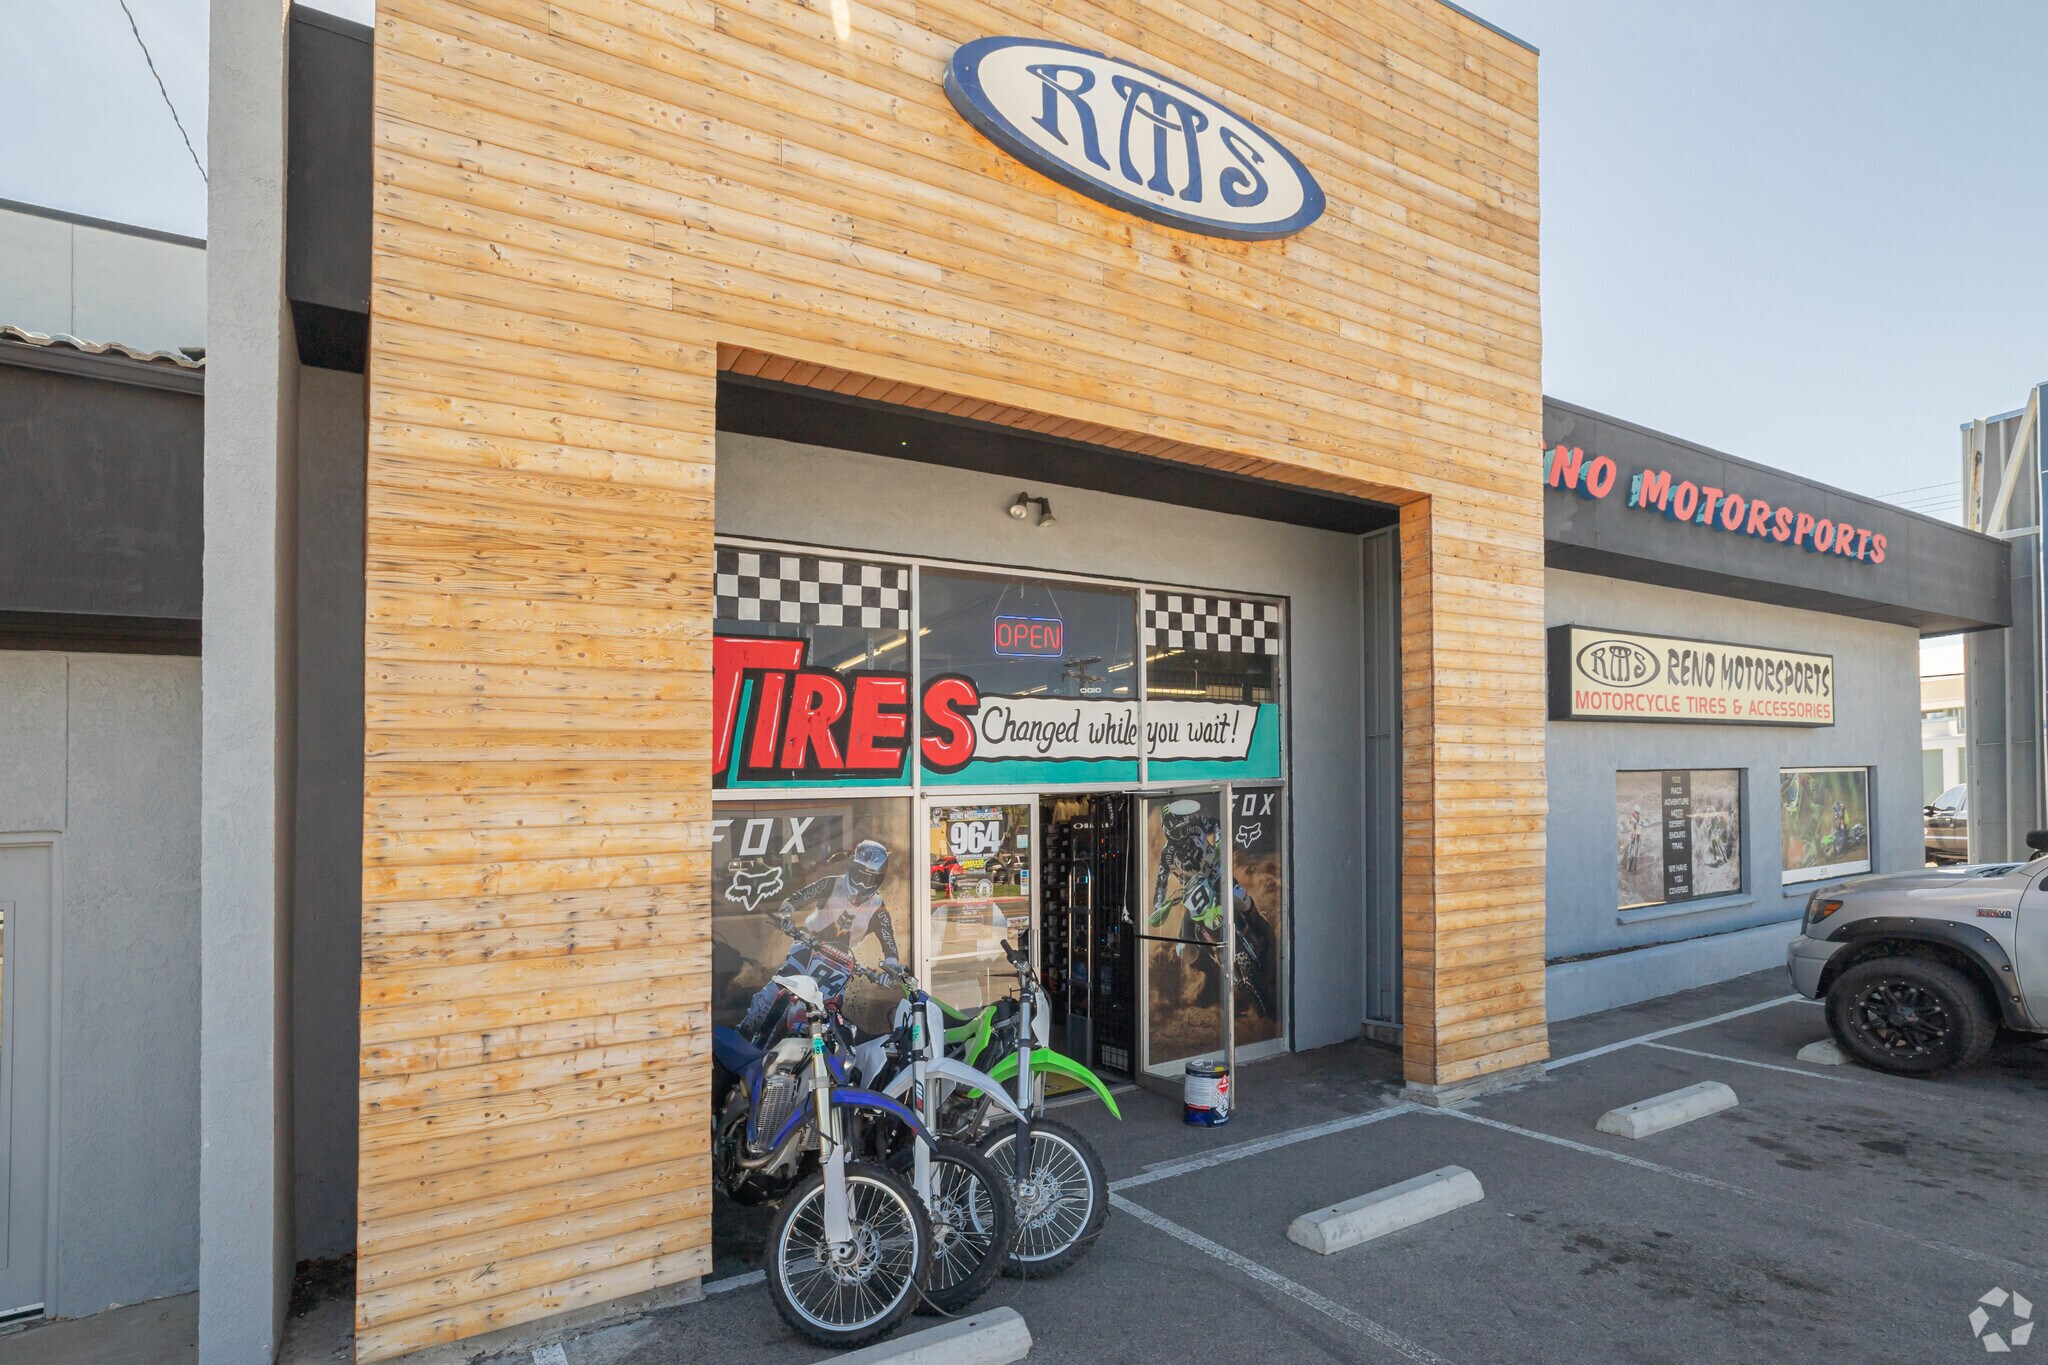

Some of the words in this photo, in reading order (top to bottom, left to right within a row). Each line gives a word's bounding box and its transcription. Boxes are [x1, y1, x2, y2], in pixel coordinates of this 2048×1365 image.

[1638, 468, 1888, 565] MOTORSPORTS
[997, 622, 1061, 650] OPEN
[1667, 648, 1715, 688] RENO
[1721, 653, 1830, 698] MOTORSPORTS
[712, 634, 979, 774] TIRES
[1575, 690, 1680, 712] MOTORCYCLE
[1686, 696, 1726, 715] TIRES
[1733, 699, 1743, 715] &
[1749, 700, 1831, 719] ACCESSORIES
[982, 705, 1080, 754] Changed
[1088, 708, 1138, 745] while
[1147, 721, 1181, 754] you
[1188, 709, 1241, 744] wait!
[1664, 797, 1690, 806] ADVENTURE
[950, 821, 1001, 855] 964
[1671, 842, 1684, 850] TRAIL
